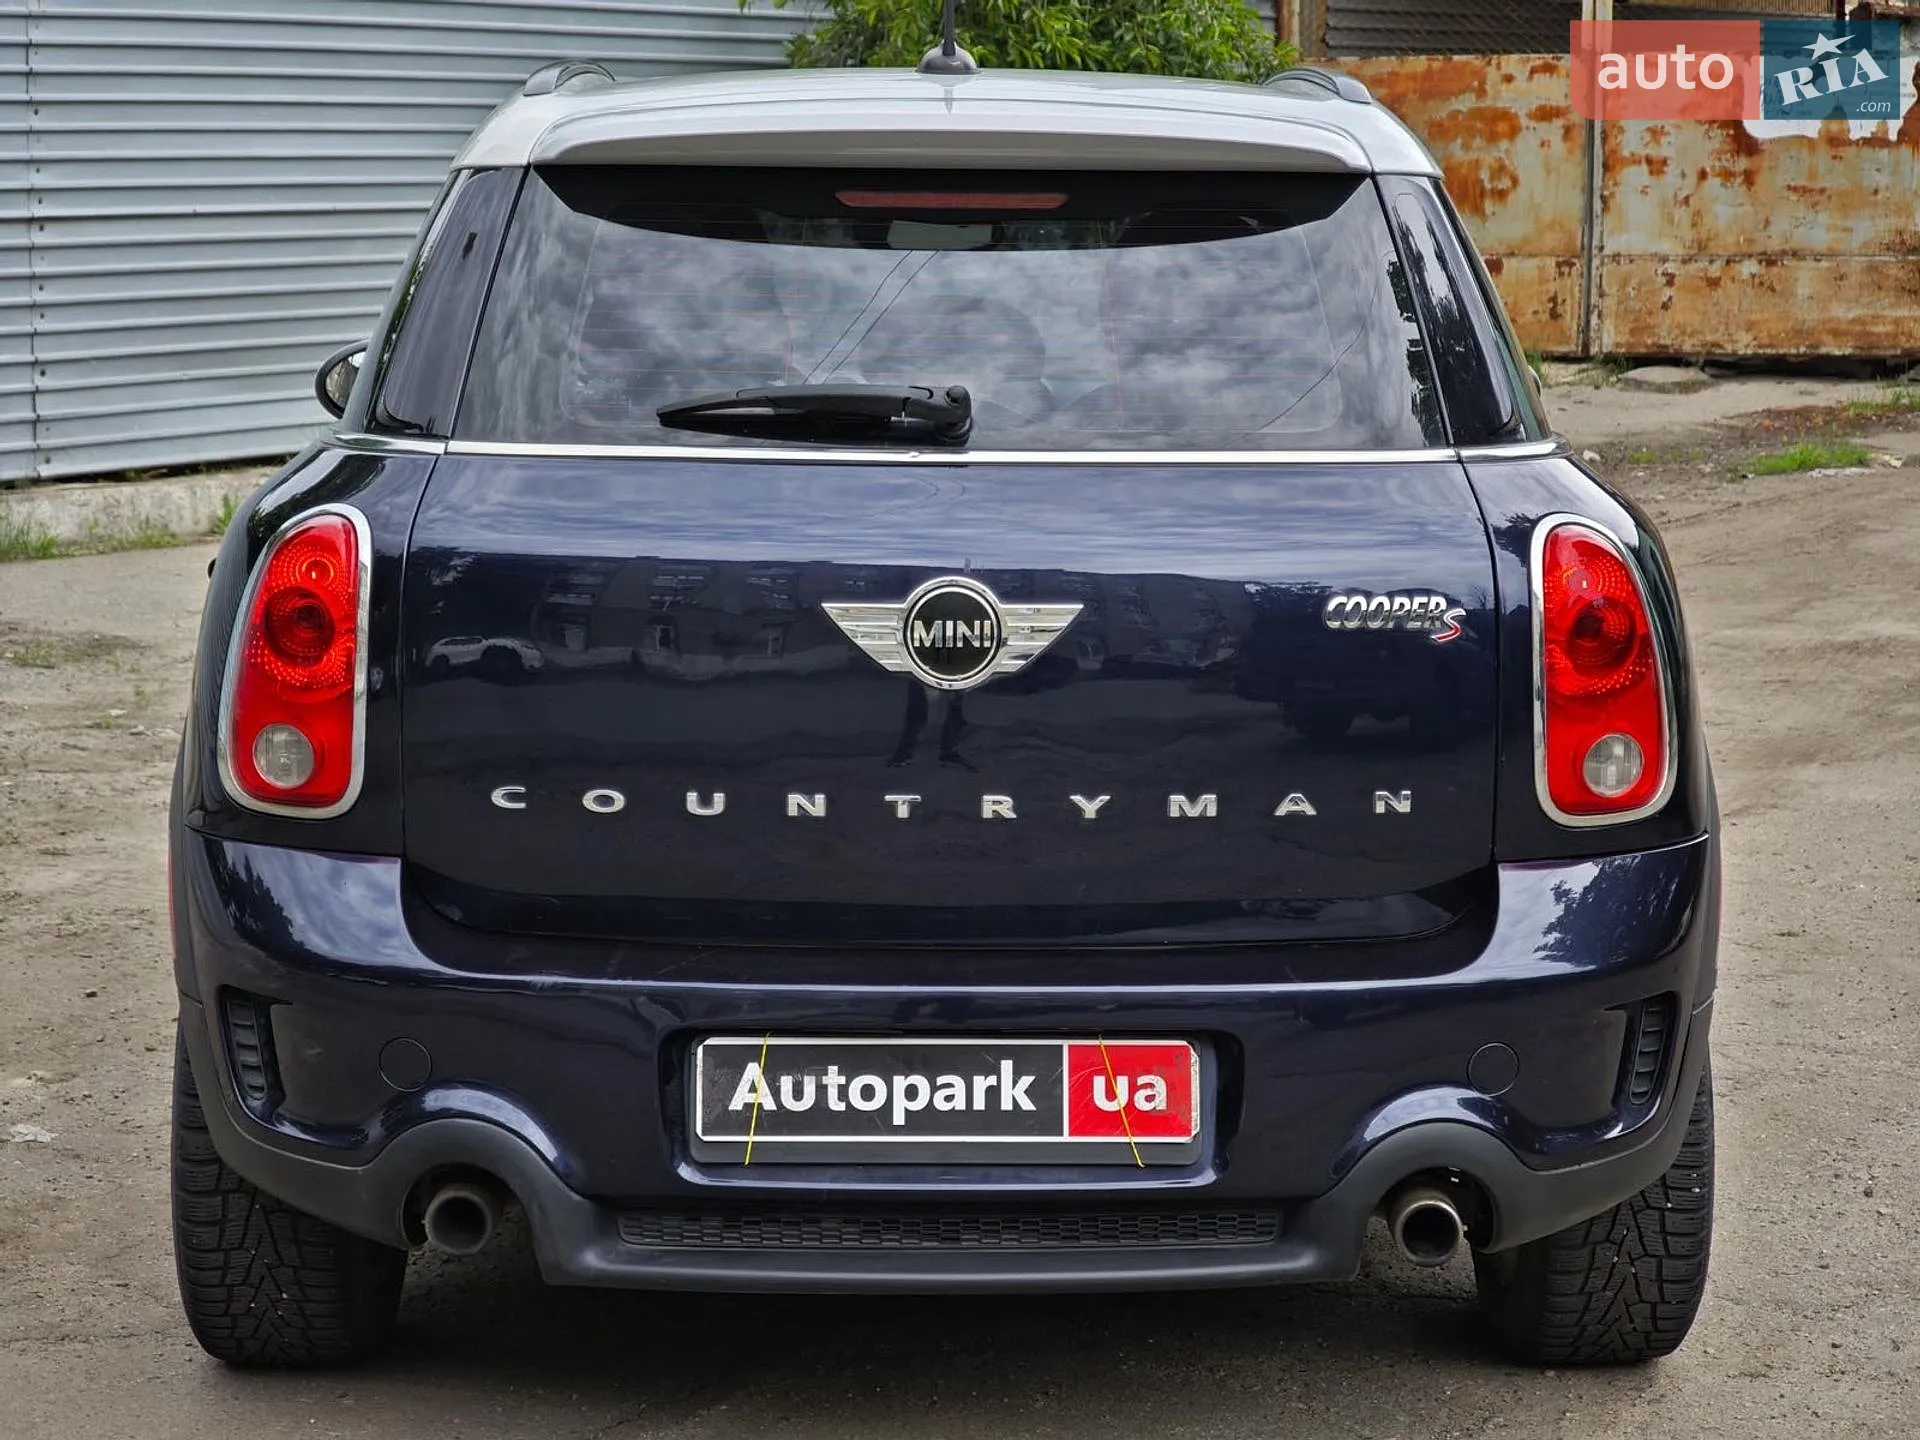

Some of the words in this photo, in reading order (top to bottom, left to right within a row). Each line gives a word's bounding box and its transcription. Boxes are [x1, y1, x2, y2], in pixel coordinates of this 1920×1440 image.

[913, 620, 992, 648] MINI
[1325, 595, 1448, 629] COOPER
[1430, 608, 1467, 642] S
[490, 785, 1412, 820] COUNTRYMAN
[728, 1061, 1037, 1126] Autopark
[1092, 1073, 1168, 1112] ua
